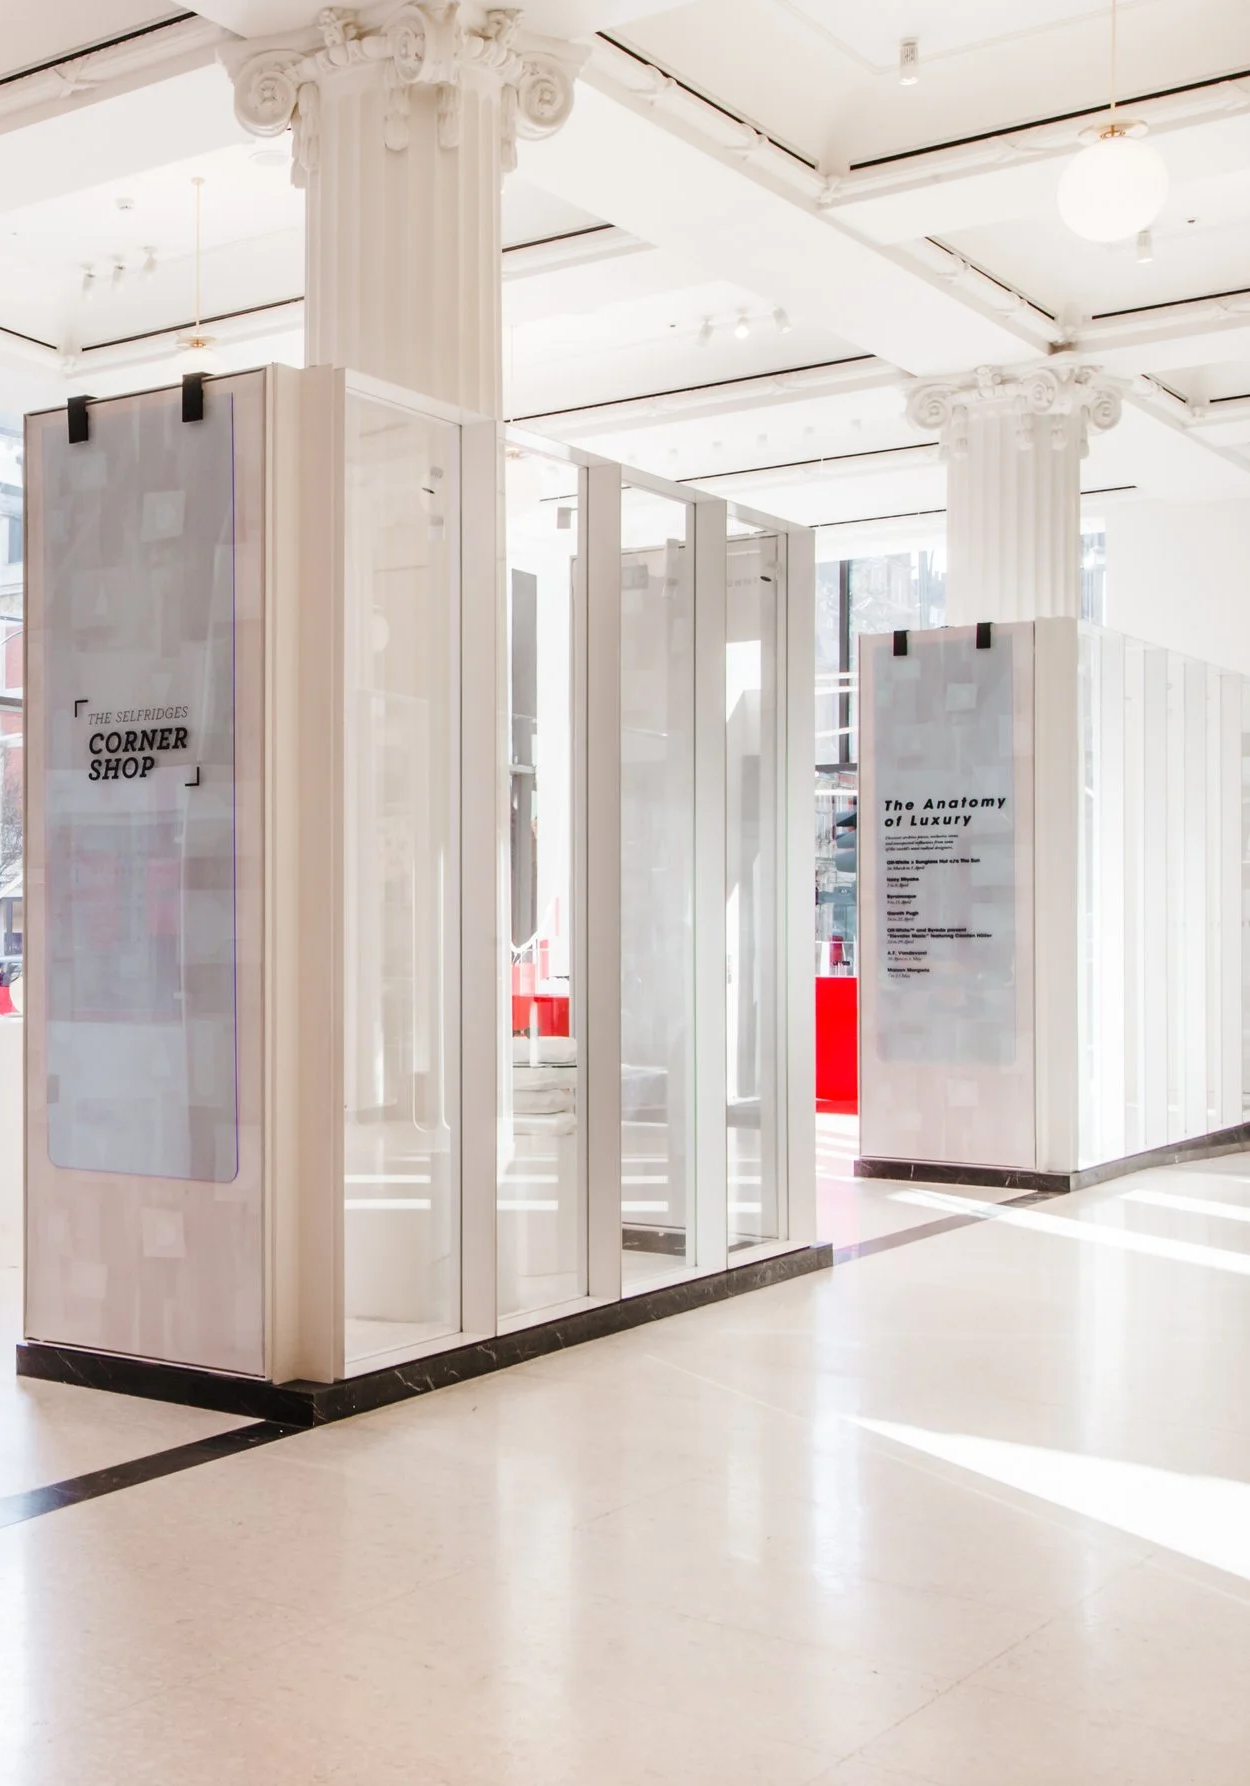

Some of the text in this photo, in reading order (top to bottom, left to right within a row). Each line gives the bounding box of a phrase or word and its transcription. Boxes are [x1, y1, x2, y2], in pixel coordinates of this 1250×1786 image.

[88, 706, 189, 725] THE SELFRIDGES
[89, 727, 188, 754] CORNER
[88, 756, 155, 781] SHOP
[884, 797, 1006, 811] The Anatomy
[884, 815, 972, 827] of Luxury
